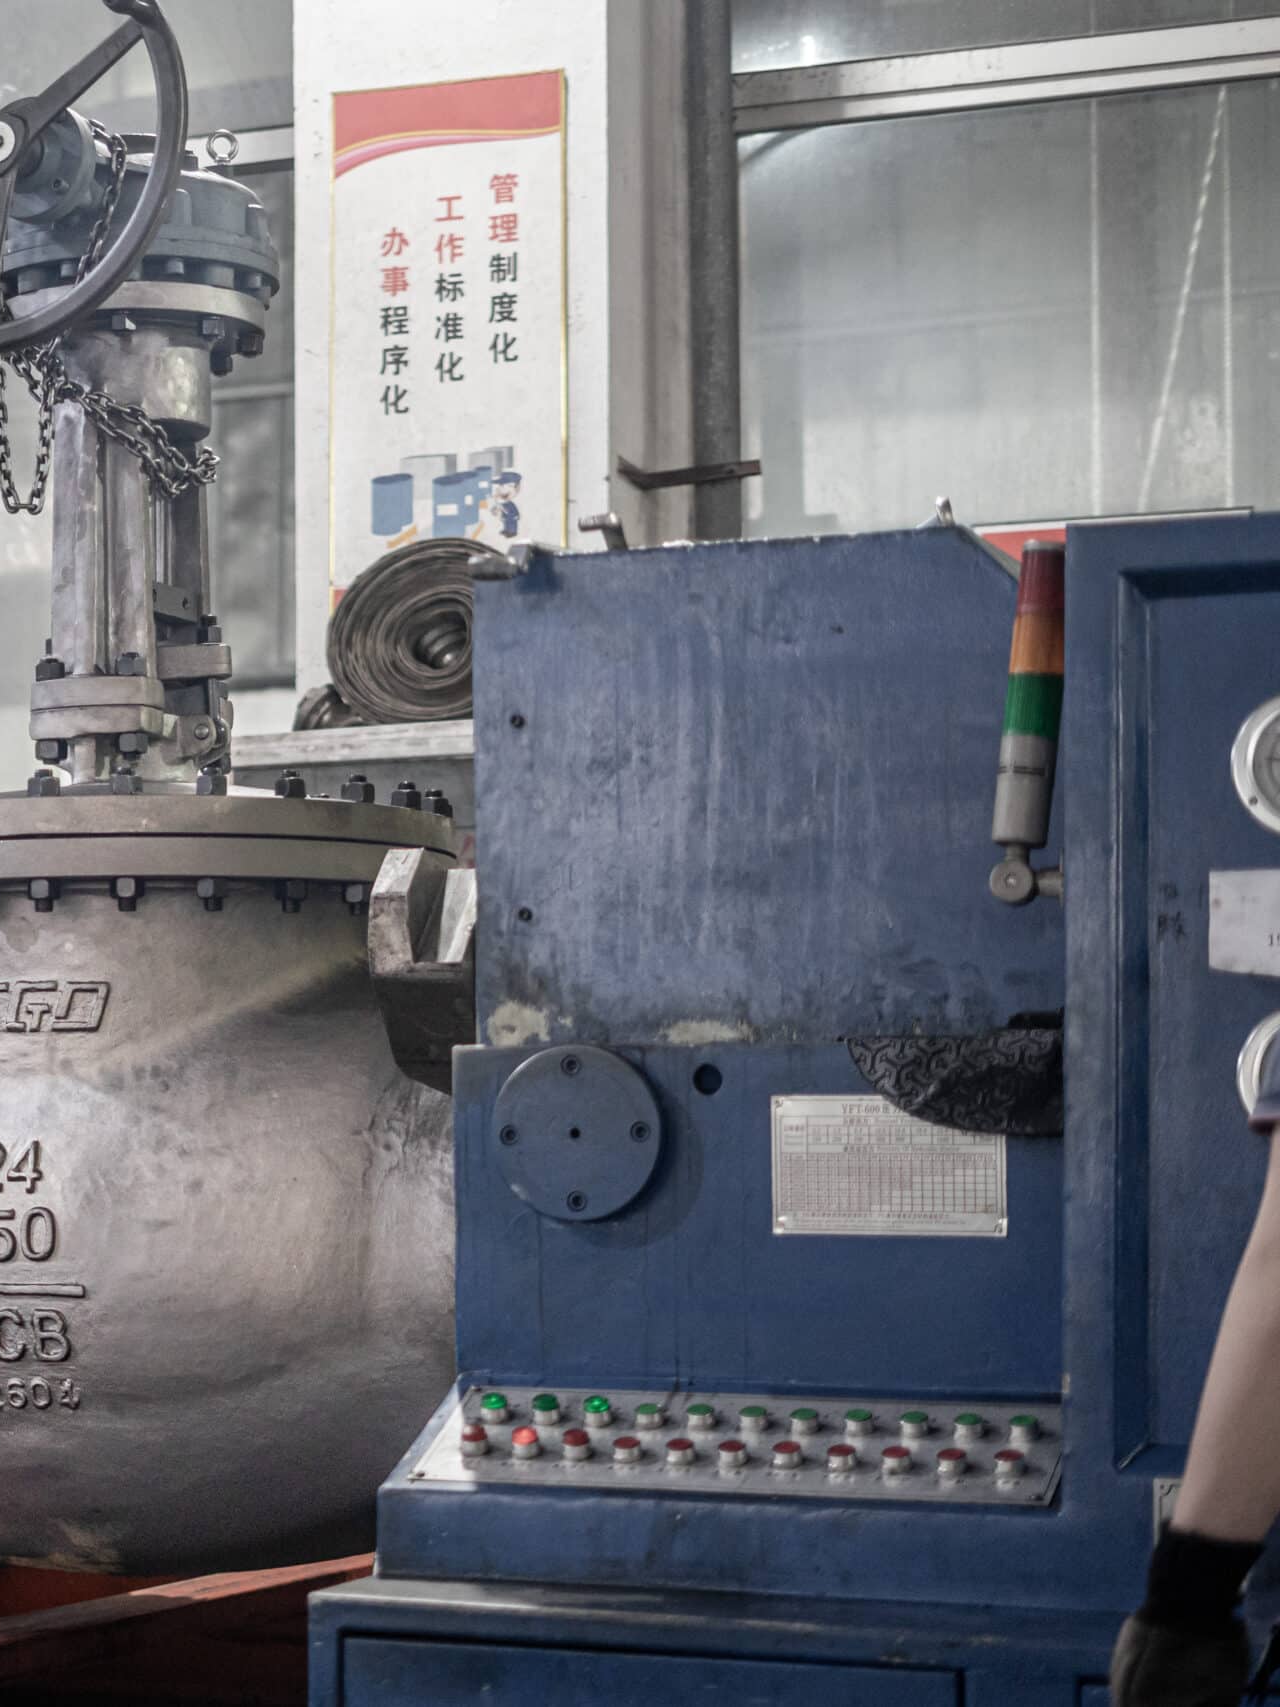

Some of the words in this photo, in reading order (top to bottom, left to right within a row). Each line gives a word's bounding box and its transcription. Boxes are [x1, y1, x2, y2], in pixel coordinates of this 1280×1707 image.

[380, 226, 411, 415] 办事程序化
[434, 195, 465, 384] 工作标准化
[489, 173, 519, 365] 管理制度化
